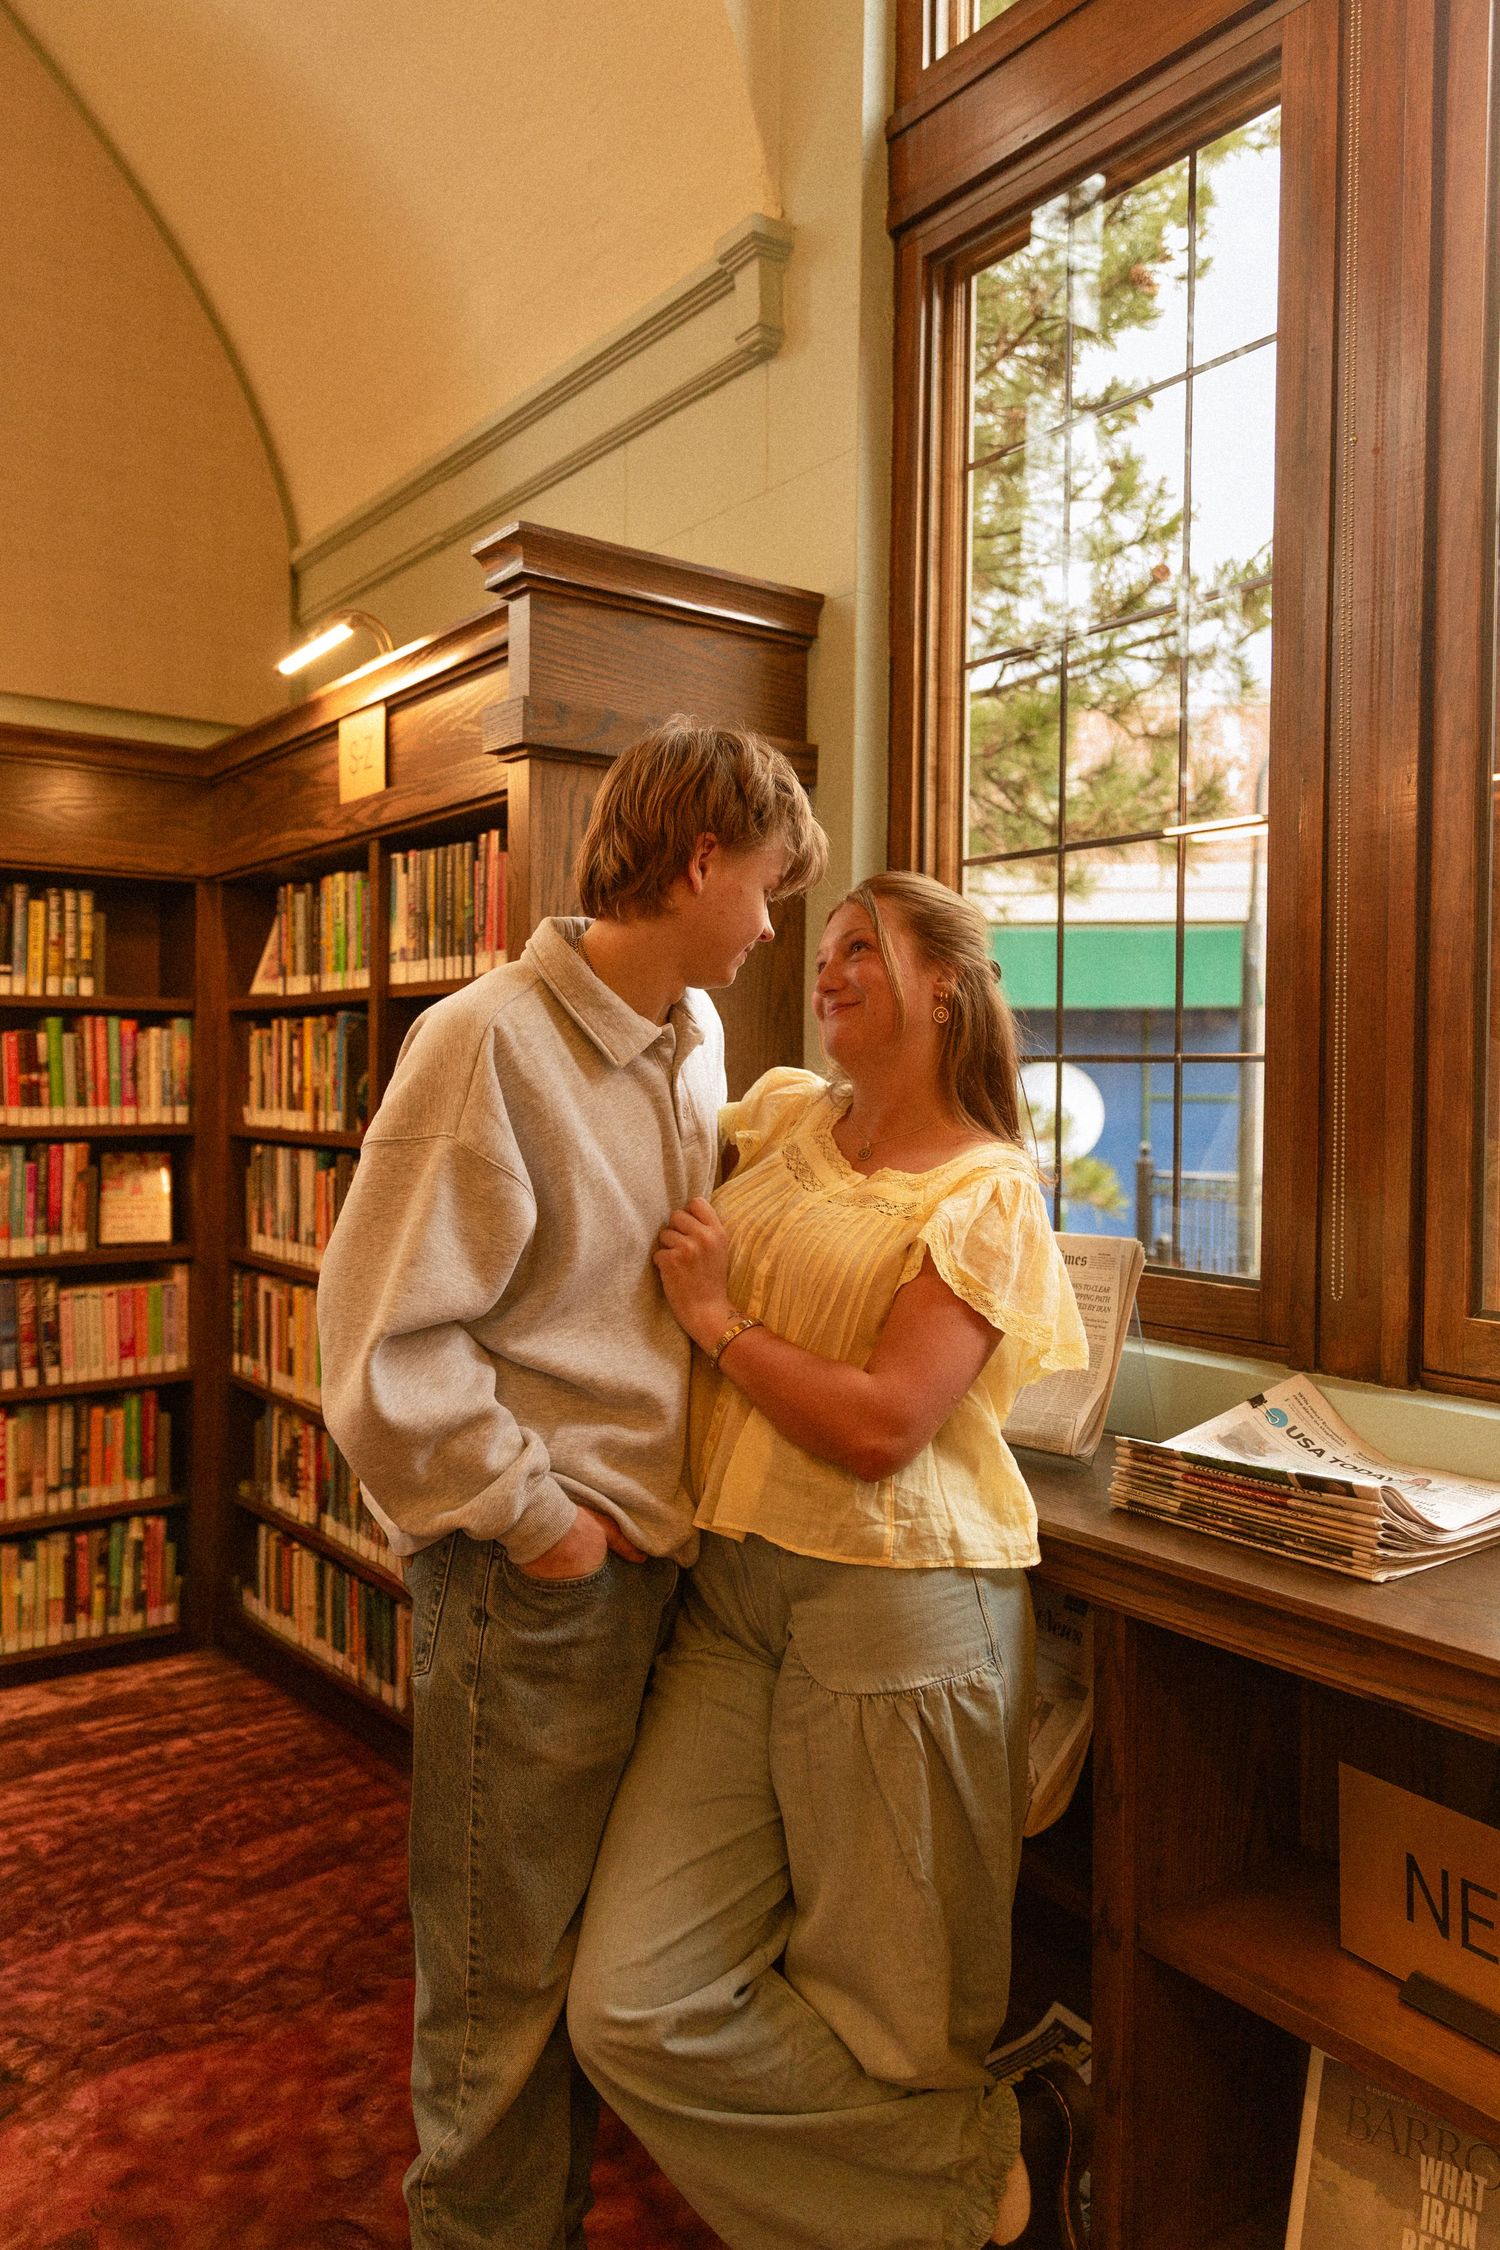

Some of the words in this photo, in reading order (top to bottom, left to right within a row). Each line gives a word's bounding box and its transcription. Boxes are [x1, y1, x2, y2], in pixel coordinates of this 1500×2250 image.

[1062, 1250, 1088, 1266] imes
[1286, 1425, 1326, 1458] USA
[1329, 1457, 1400, 1482] TODAY
[1420, 2153, 1489, 2213] WHAT
[1420, 2194, 1479, 2250] IRAN
